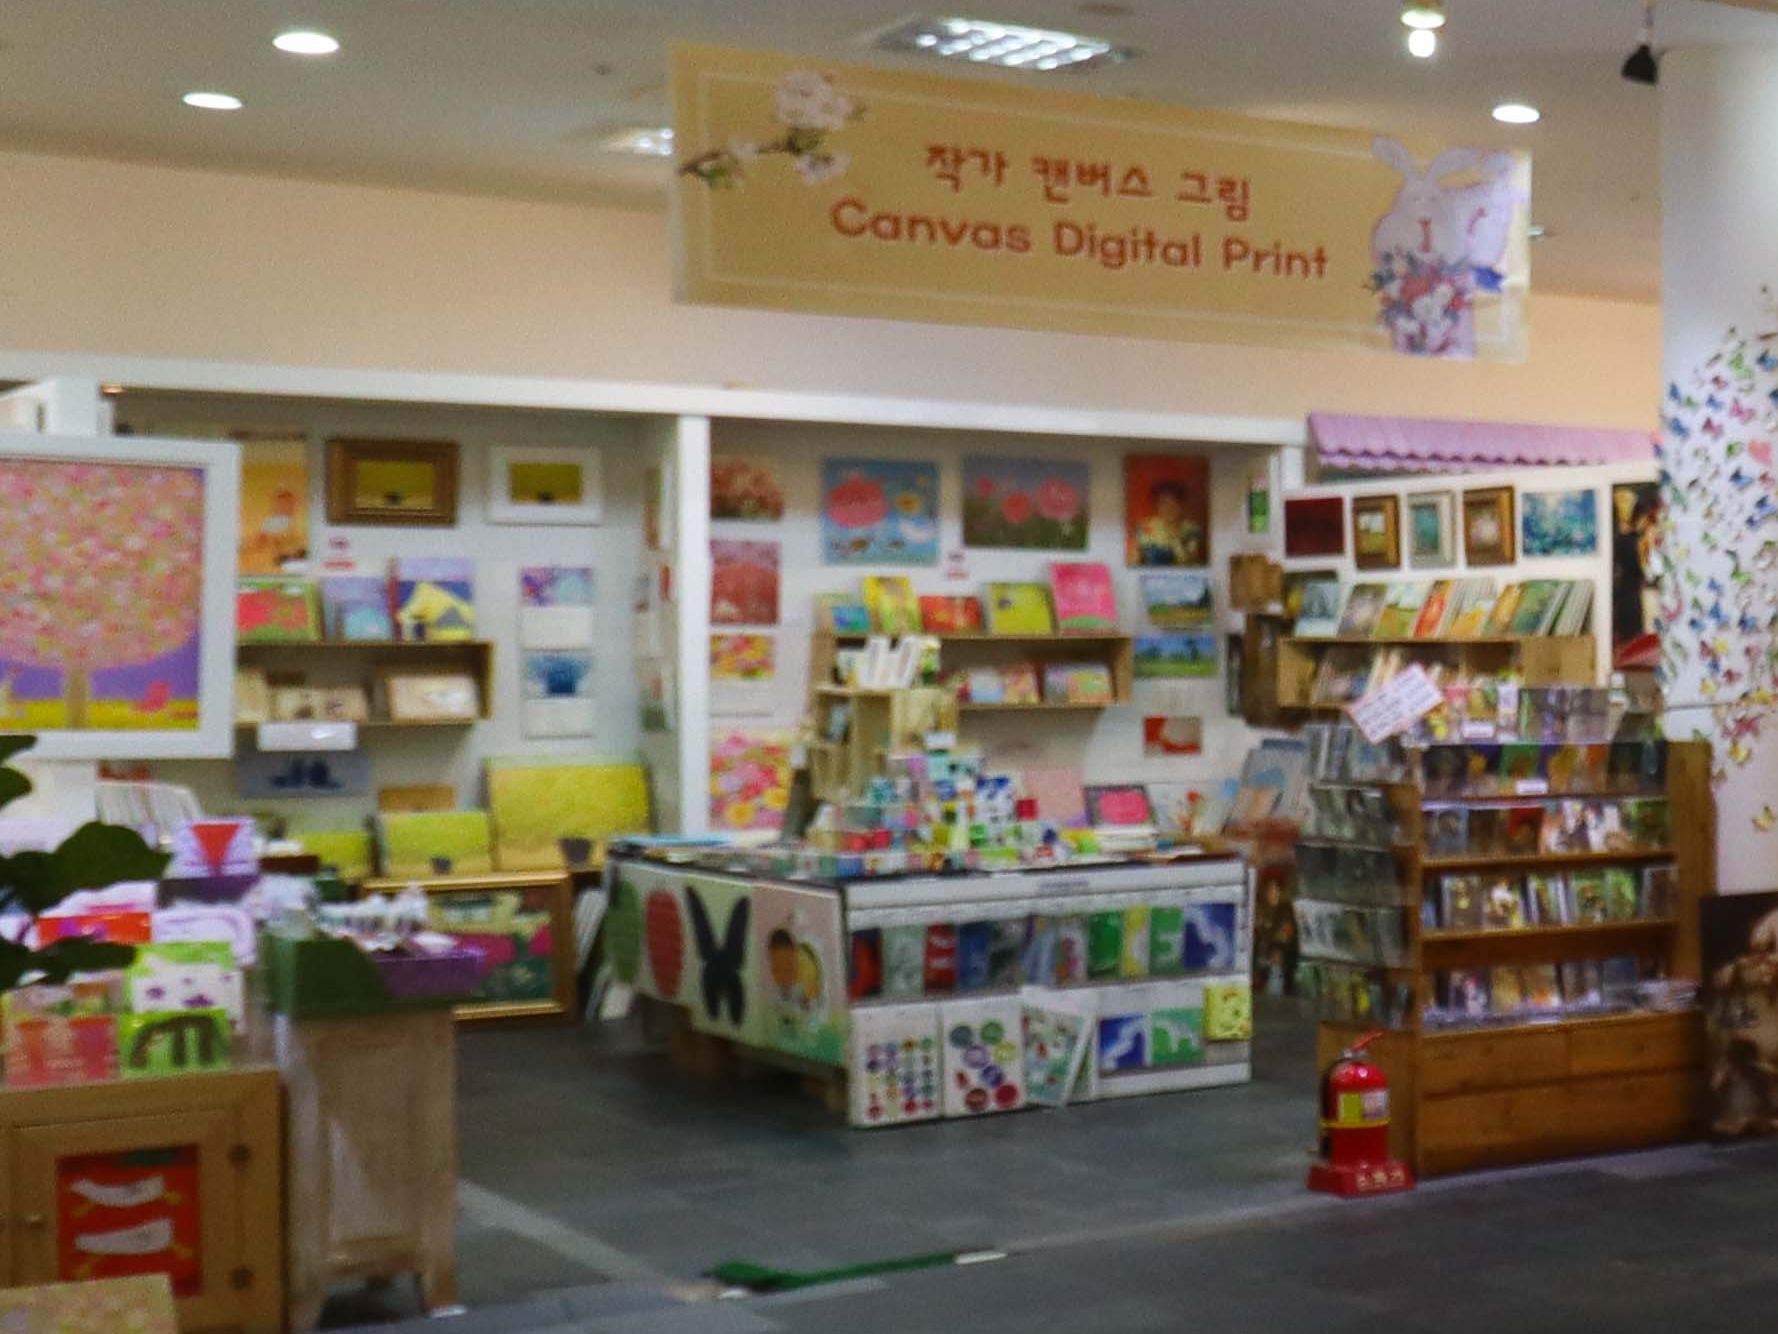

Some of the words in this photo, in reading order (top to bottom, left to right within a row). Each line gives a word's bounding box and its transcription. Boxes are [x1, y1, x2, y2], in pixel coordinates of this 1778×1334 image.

[926, 144, 1008, 193] 작가
[1031, 155, 1152, 205] 캔버스
[1173, 167, 1250, 222] 그림
[830, 197, 1031, 253] Canvas
[1053, 219, 1202, 270] Digital
[1222, 234, 1328, 280] Print
